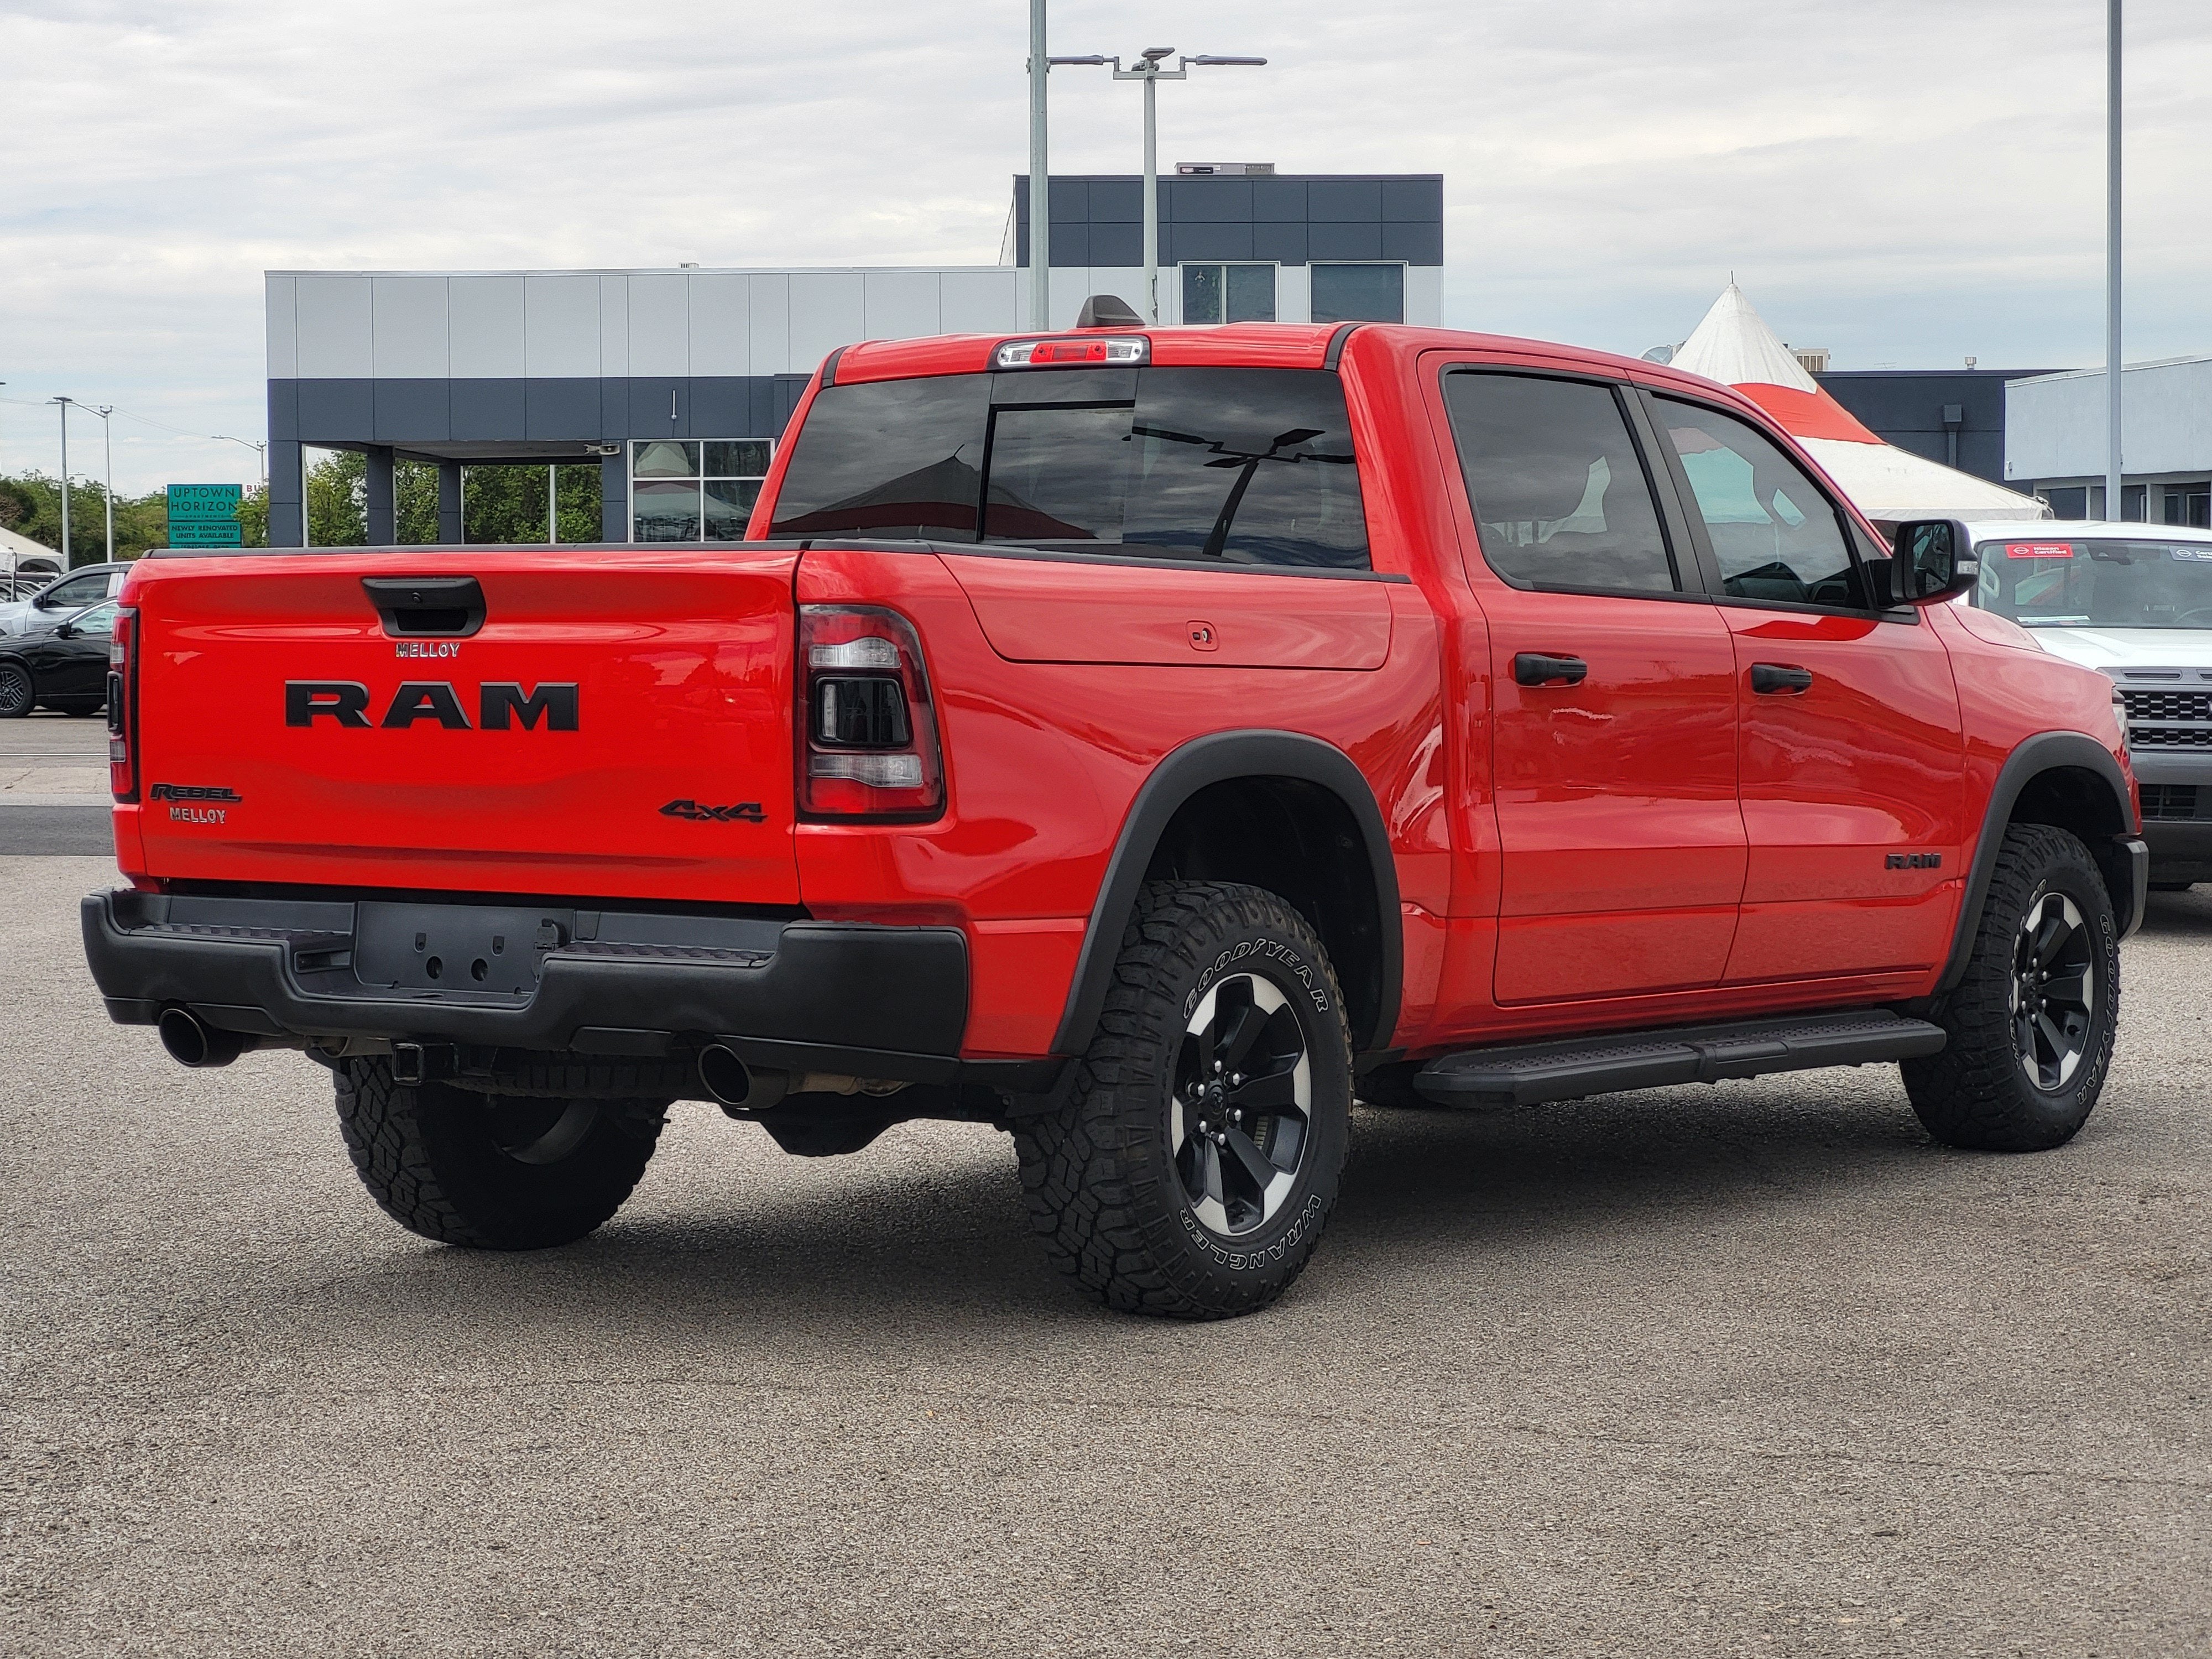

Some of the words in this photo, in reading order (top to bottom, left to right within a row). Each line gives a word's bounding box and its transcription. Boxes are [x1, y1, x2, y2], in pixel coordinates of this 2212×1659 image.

[174, 488, 234, 497] UPTOWN
[171, 502, 237, 511] HORIZON
[395, 643, 460, 658] MELLOY
[285, 680, 579, 731] RAM
[150, 782, 242, 801] REBEL
[169, 807, 226, 824] MELLOY
[1885, 853, 1941, 869] RAM
[1183, 938, 1329, 1019] GOODYEAR
[1180, 1194, 1322, 1270] WRANGLER
